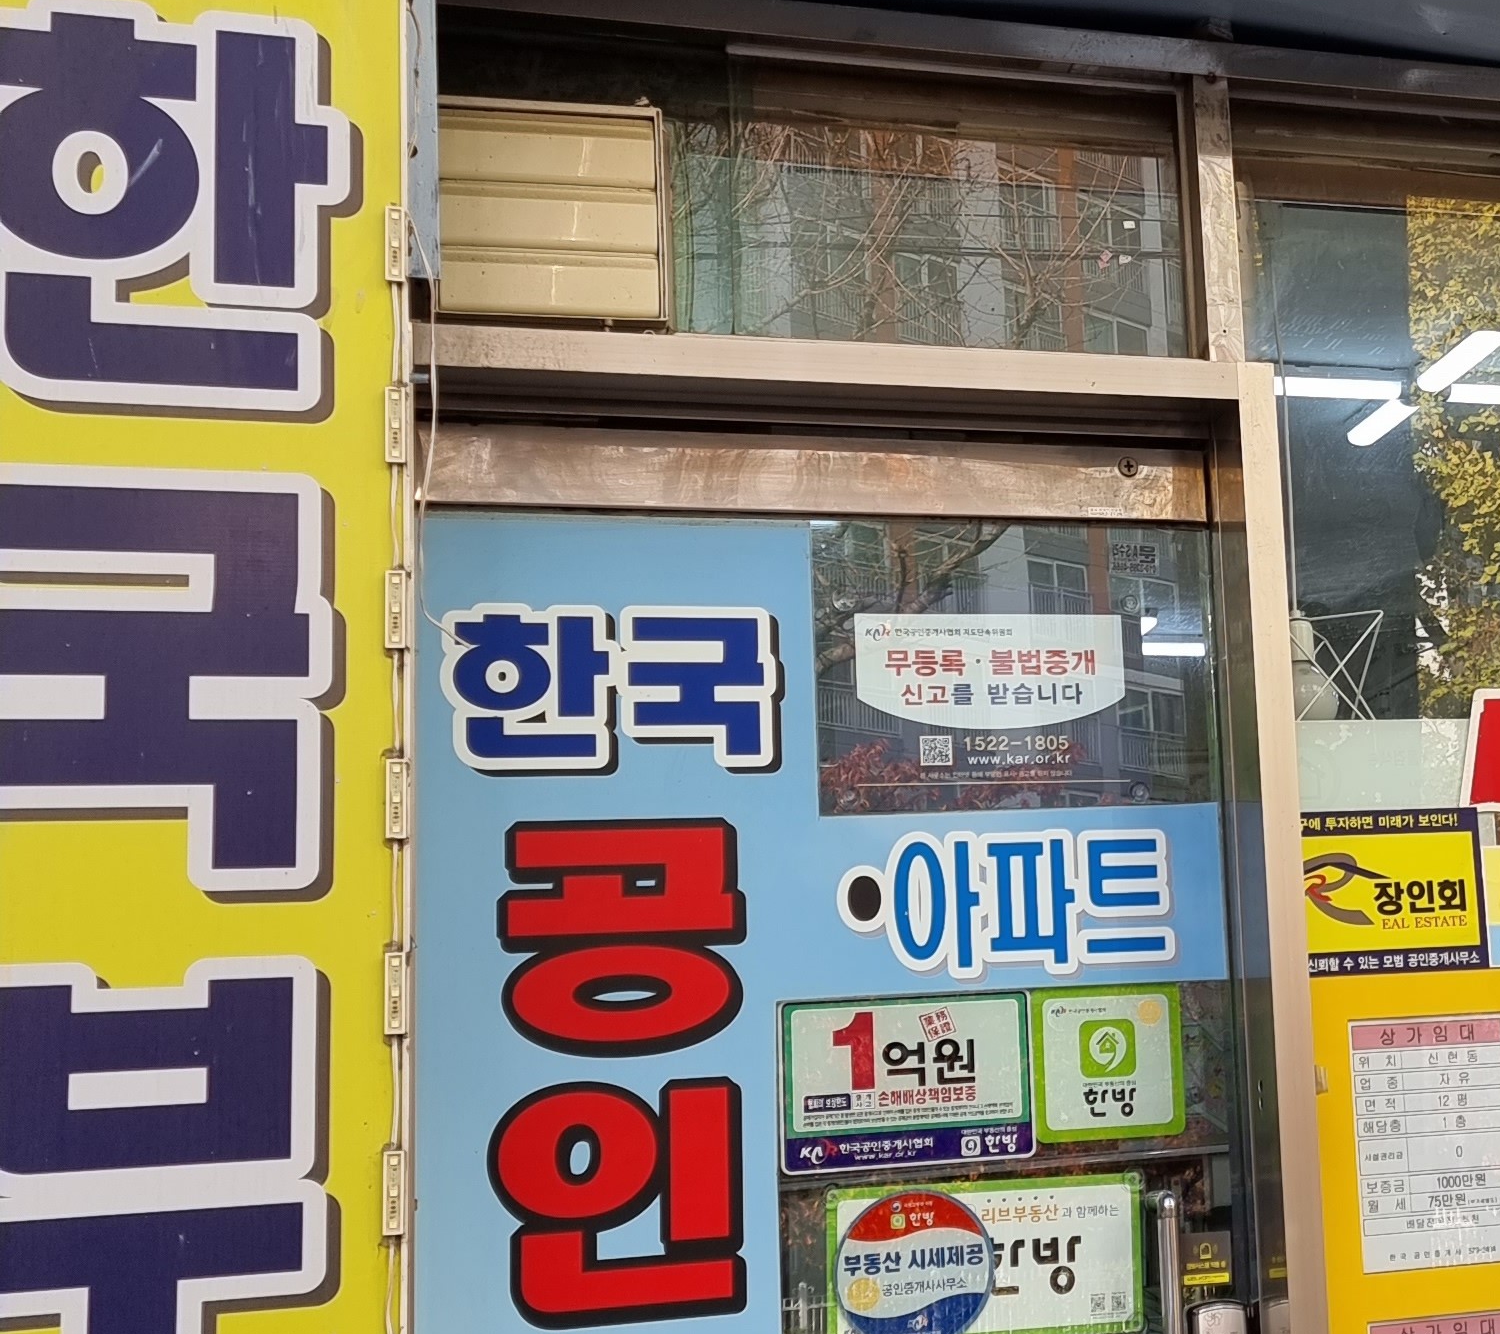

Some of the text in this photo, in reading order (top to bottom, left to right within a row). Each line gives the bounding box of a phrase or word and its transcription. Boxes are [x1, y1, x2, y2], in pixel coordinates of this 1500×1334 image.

[885, 649, 1096, 676] 무등록 불법중개
[452, 612, 773, 759] 한국
[901, 683, 1083, 706] 신고를 받습니다
[964, 736, 1069, 751] 1522-1805
[967, 752, 1070, 765] www.kar.or.kr
[1325, 816, 1373, 830] 투자하면
[1378, 814, 1413, 829] 미래가
[1418, 813, 1458, 827] 보인다!
[893, 838, 1167, 970] 아파트
[1374, 879, 1467, 915] 장인회
[1415, 915, 1467, 928] ESTATE
[1343, 957, 1354, 970] 수
[1358, 956, 1379, 969] 있는
[1383, 955, 1404, 968] 모범
[1407, 951, 1480, 967] 공인중개사무소
[832, 1011, 976, 1091] 1억원
[878, 1085, 976, 1107] 손해배상책임보증
[1083, 1087, 1136, 1117] 한방
[840, 1137, 934, 1154] 한국공인중개사협회
[985, 1134, 1017, 1153] 한방
[1367, 1173, 1486, 1194] 보증금 1000만원
[1076, 1204, 1119, 1219] 함께하는
[844, 1243, 983, 1276] 부동산 시세제공
[882, 1277, 967, 1297] 공인중개사사무소
